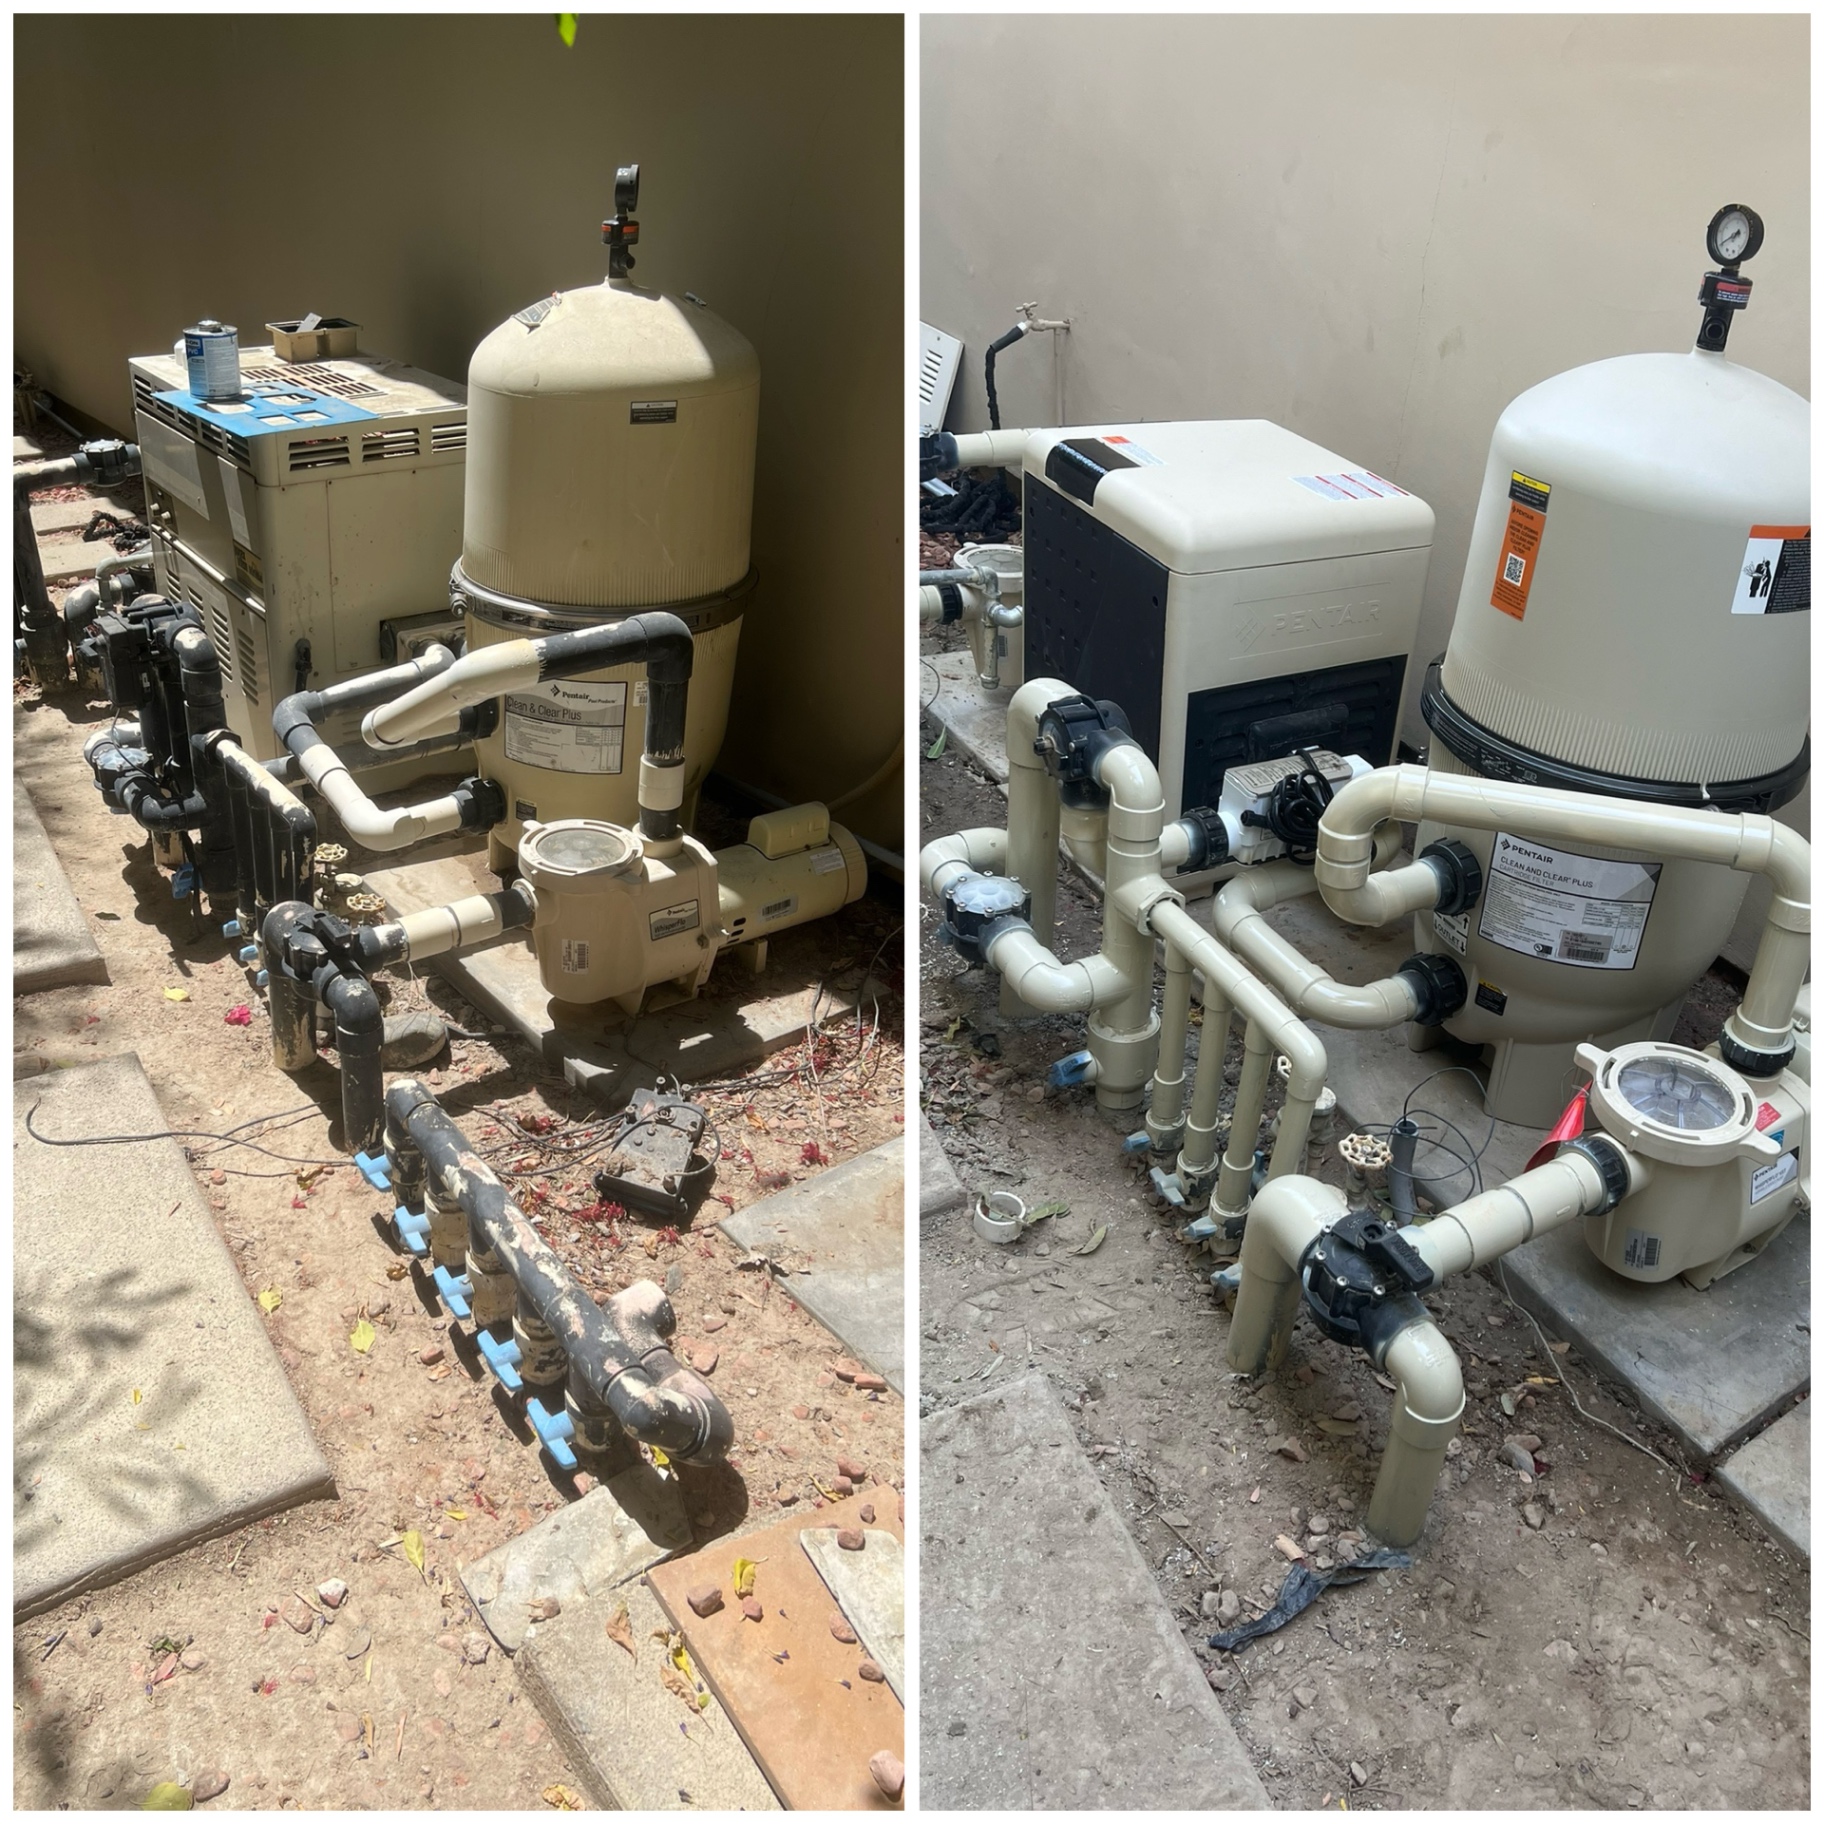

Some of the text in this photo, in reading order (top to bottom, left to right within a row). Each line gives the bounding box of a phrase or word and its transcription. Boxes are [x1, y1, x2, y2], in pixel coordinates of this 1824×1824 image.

[1271, 599, 1382, 637] PENTAIR
[562, 691, 590, 700] Pentair
[507, 696, 582, 720] Clean & Clear Plus
[1511, 844, 1554, 865] PENTAIR
[1499, 864, 1554, 887] CARTRIDGE FILTER
[1500, 855, 1525, 871] CLEAN
[1525, 865, 1542, 876] AND
[1572, 876, 1594, 888] PLUS
[1437, 923, 1460, 945] OUTLET
